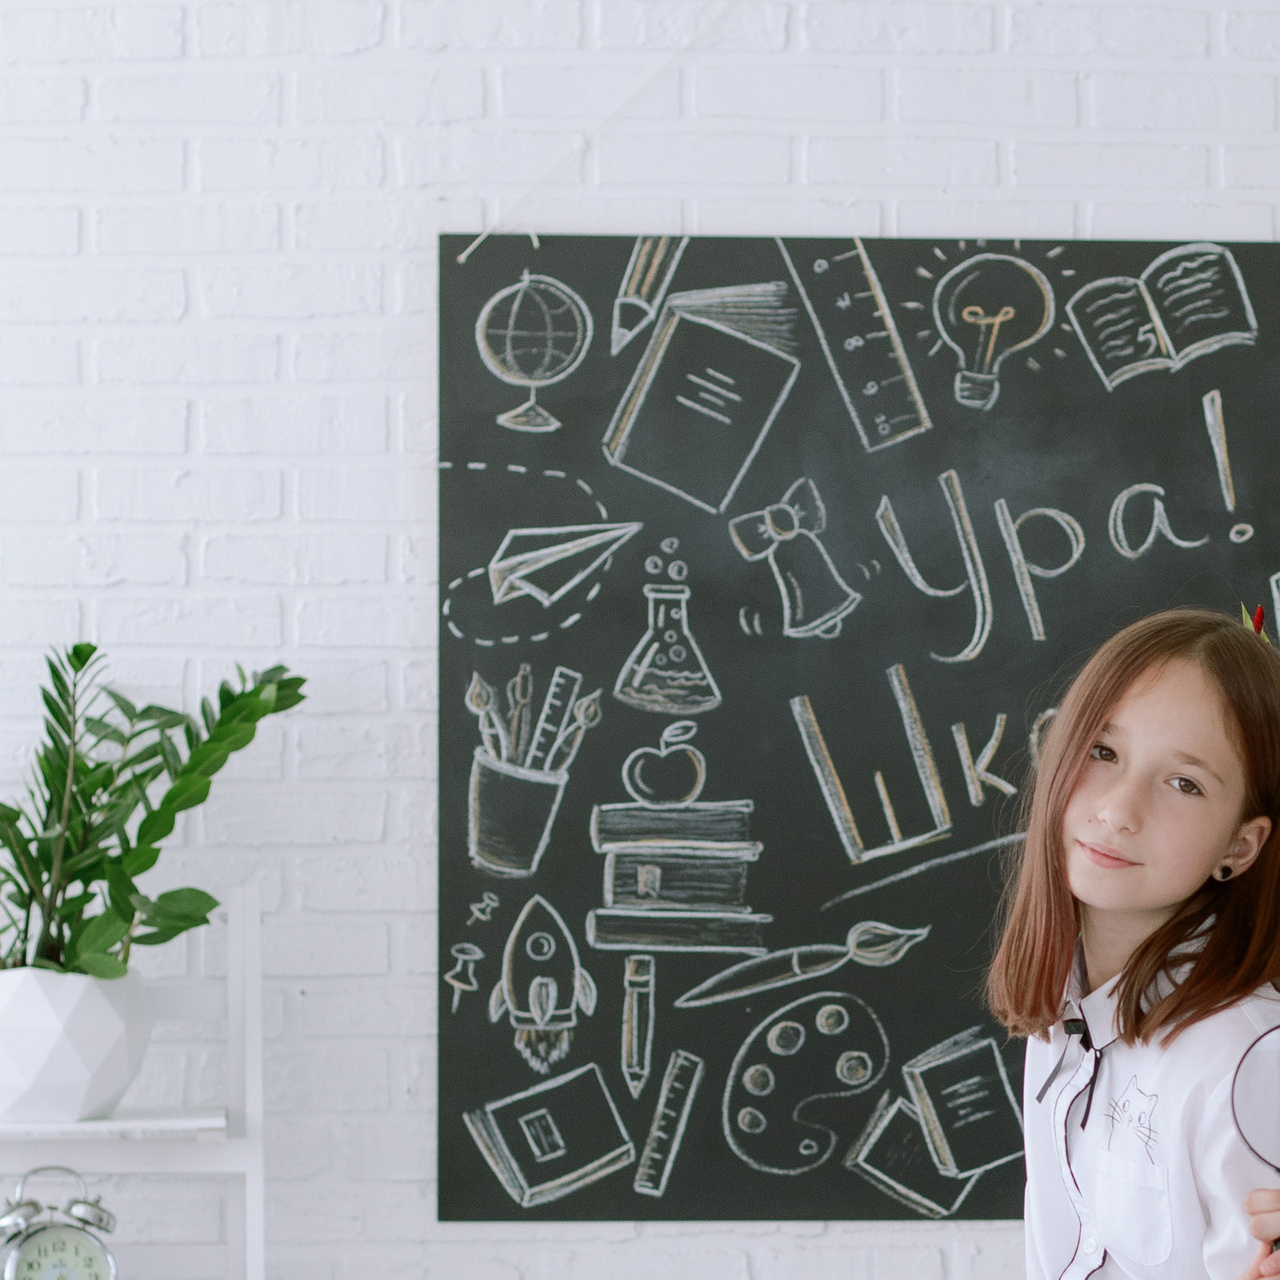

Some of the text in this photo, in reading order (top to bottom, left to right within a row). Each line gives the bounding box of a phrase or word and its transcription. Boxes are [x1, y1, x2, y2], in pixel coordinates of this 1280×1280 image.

[843, 335, 866, 352] 8
[873, 412, 891, 437] 10
[875, 389, 1255, 664] Ура!
